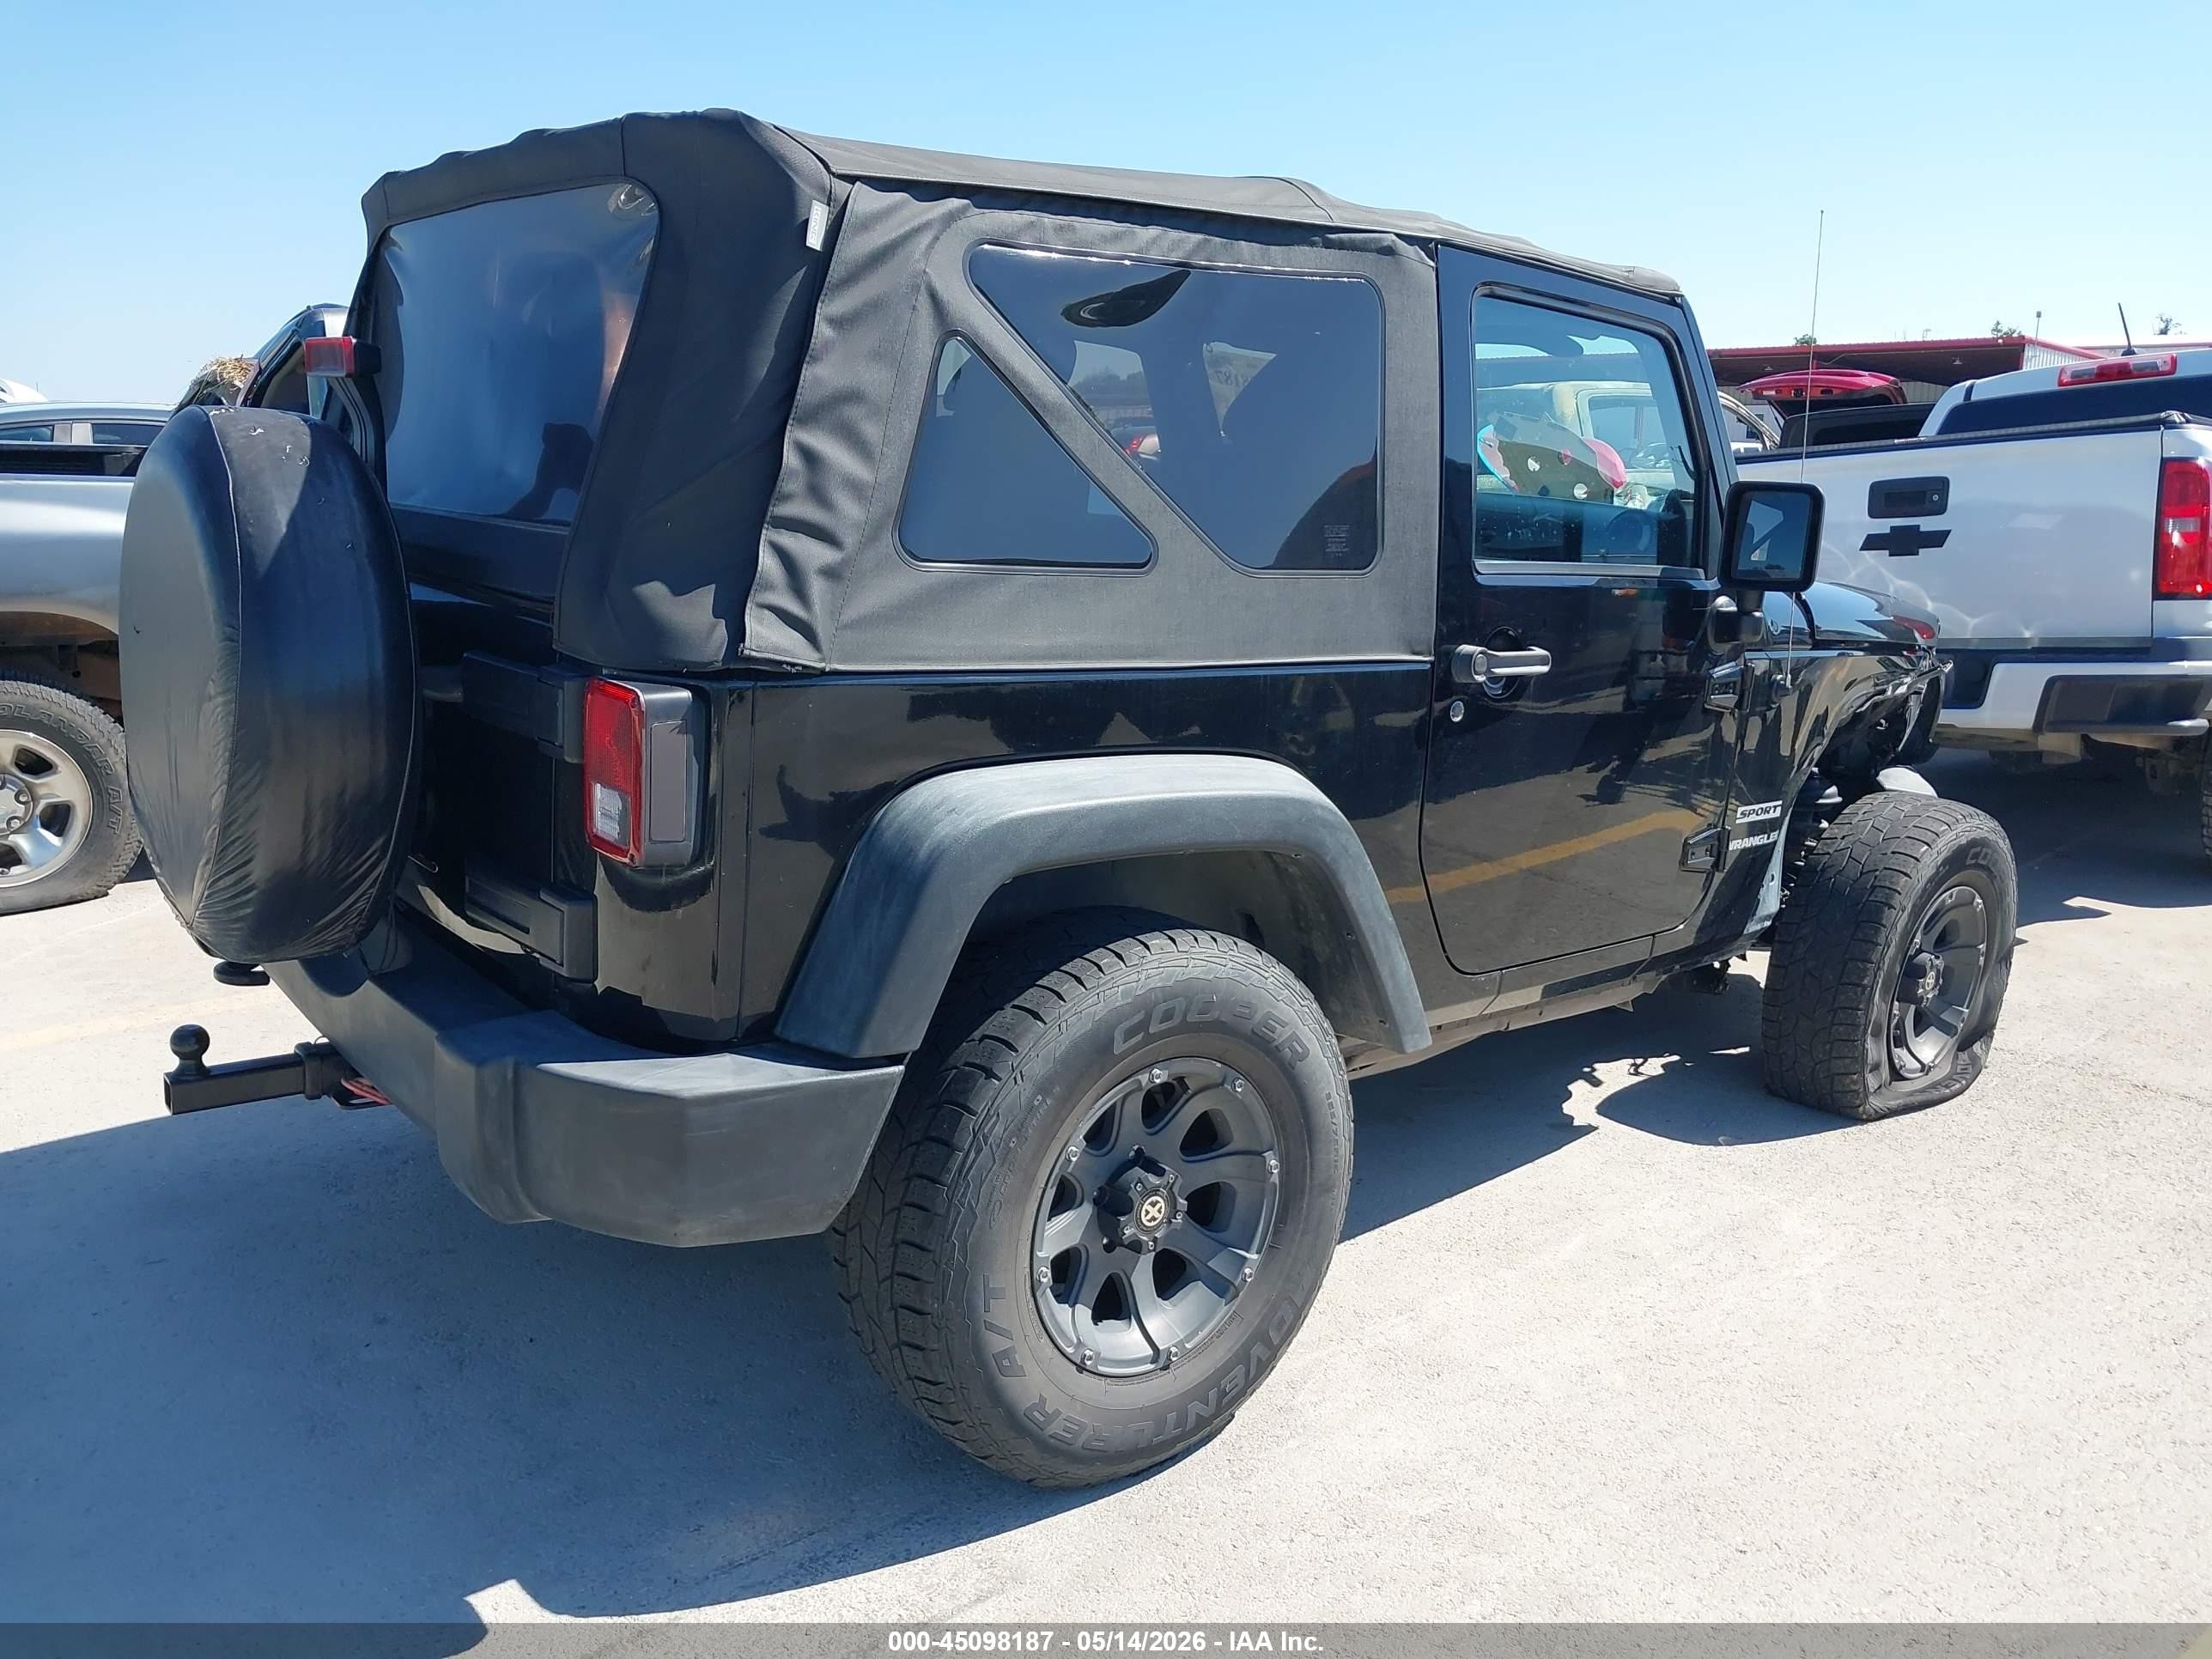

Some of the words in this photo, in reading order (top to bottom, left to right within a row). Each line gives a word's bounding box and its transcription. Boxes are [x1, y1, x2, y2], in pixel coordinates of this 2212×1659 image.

[107, 786, 122, 835] A/T
[1737, 804, 1782, 820] SPORT
[1729, 830, 1779, 851] RANGLE
[1113, 994, 1311, 1071] COOPER
[982, 1273, 1028, 1378] A/T
